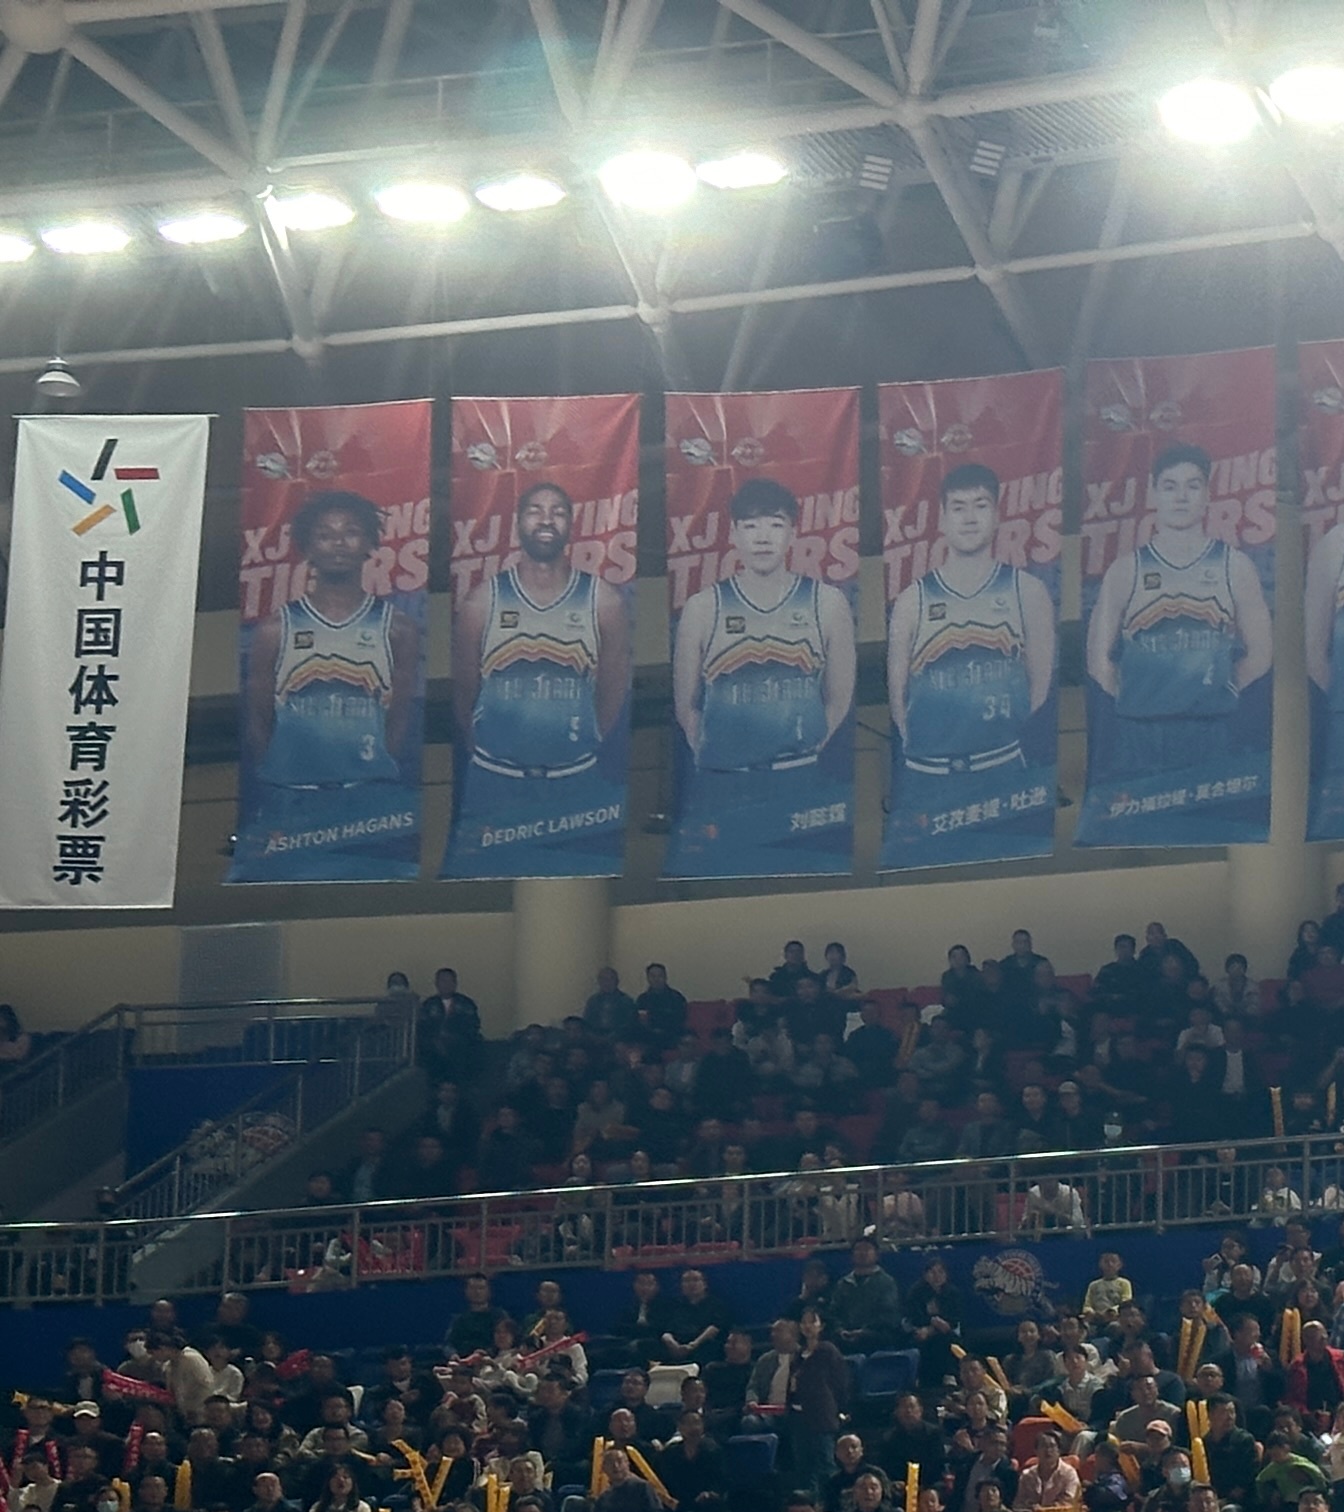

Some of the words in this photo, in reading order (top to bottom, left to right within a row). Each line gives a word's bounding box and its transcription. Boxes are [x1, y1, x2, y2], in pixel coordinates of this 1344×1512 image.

[53, 549, 128, 887] 中国体育彩票
[264, 826, 339, 854] ASHTON
[341, 811, 415, 839] HAGANS
[481, 820, 543, 848] DEDRIC
[546, 804, 619, 834] LAWSON
